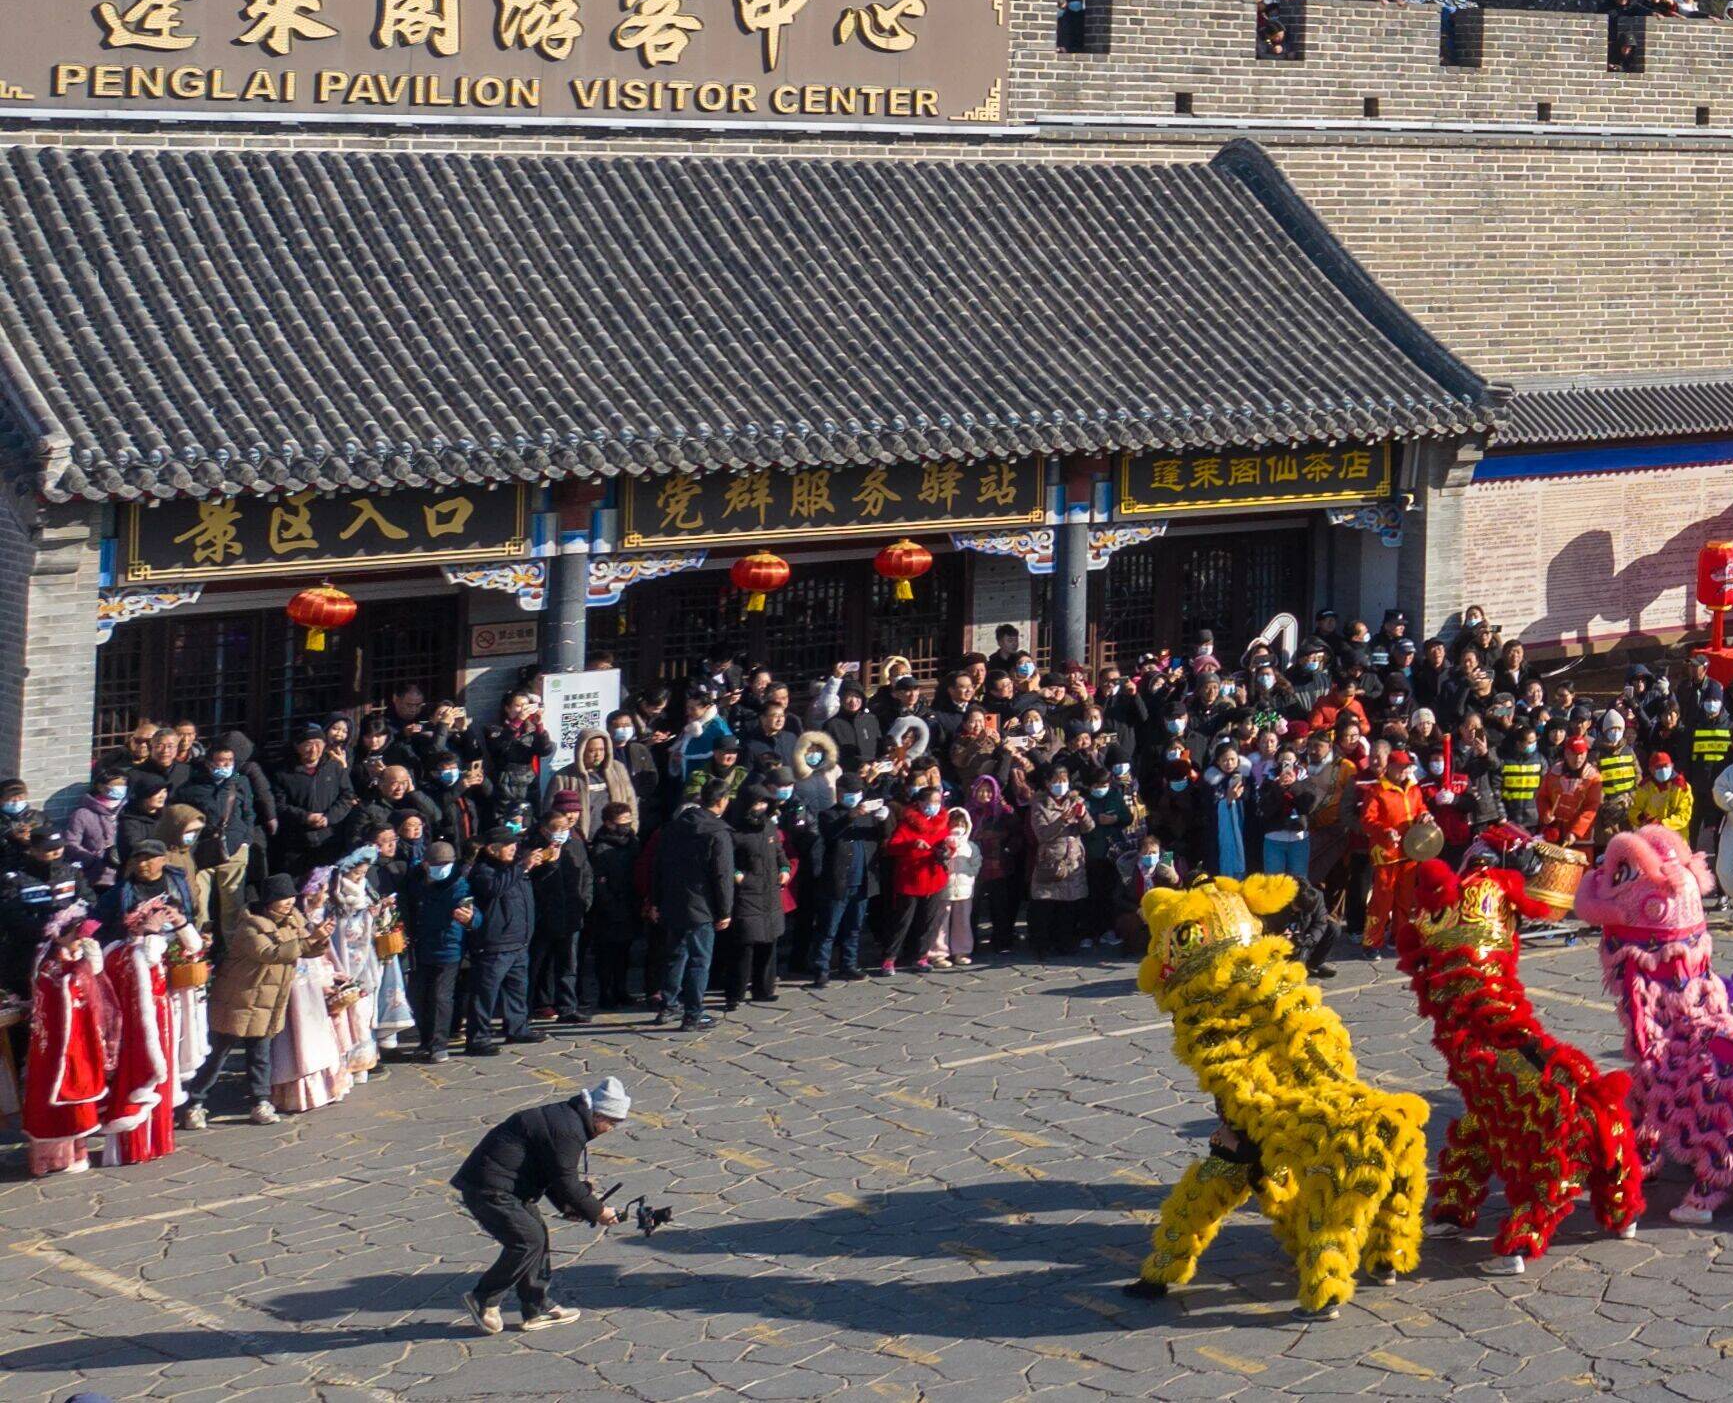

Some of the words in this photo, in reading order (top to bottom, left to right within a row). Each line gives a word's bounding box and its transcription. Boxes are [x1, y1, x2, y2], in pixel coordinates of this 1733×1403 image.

[52, 63, 297, 103] PENGLAI
[316, 69, 541, 108] PAVILION
[570, 77, 758, 112] VISITOR
[769, 84, 940, 118] CENTER
[655, 461, 1019, 530] 党群服务驿站
[1150, 449, 1373, 493] 蓬莱阁仙茶店
[173, 494, 475, 564] 景区入口
